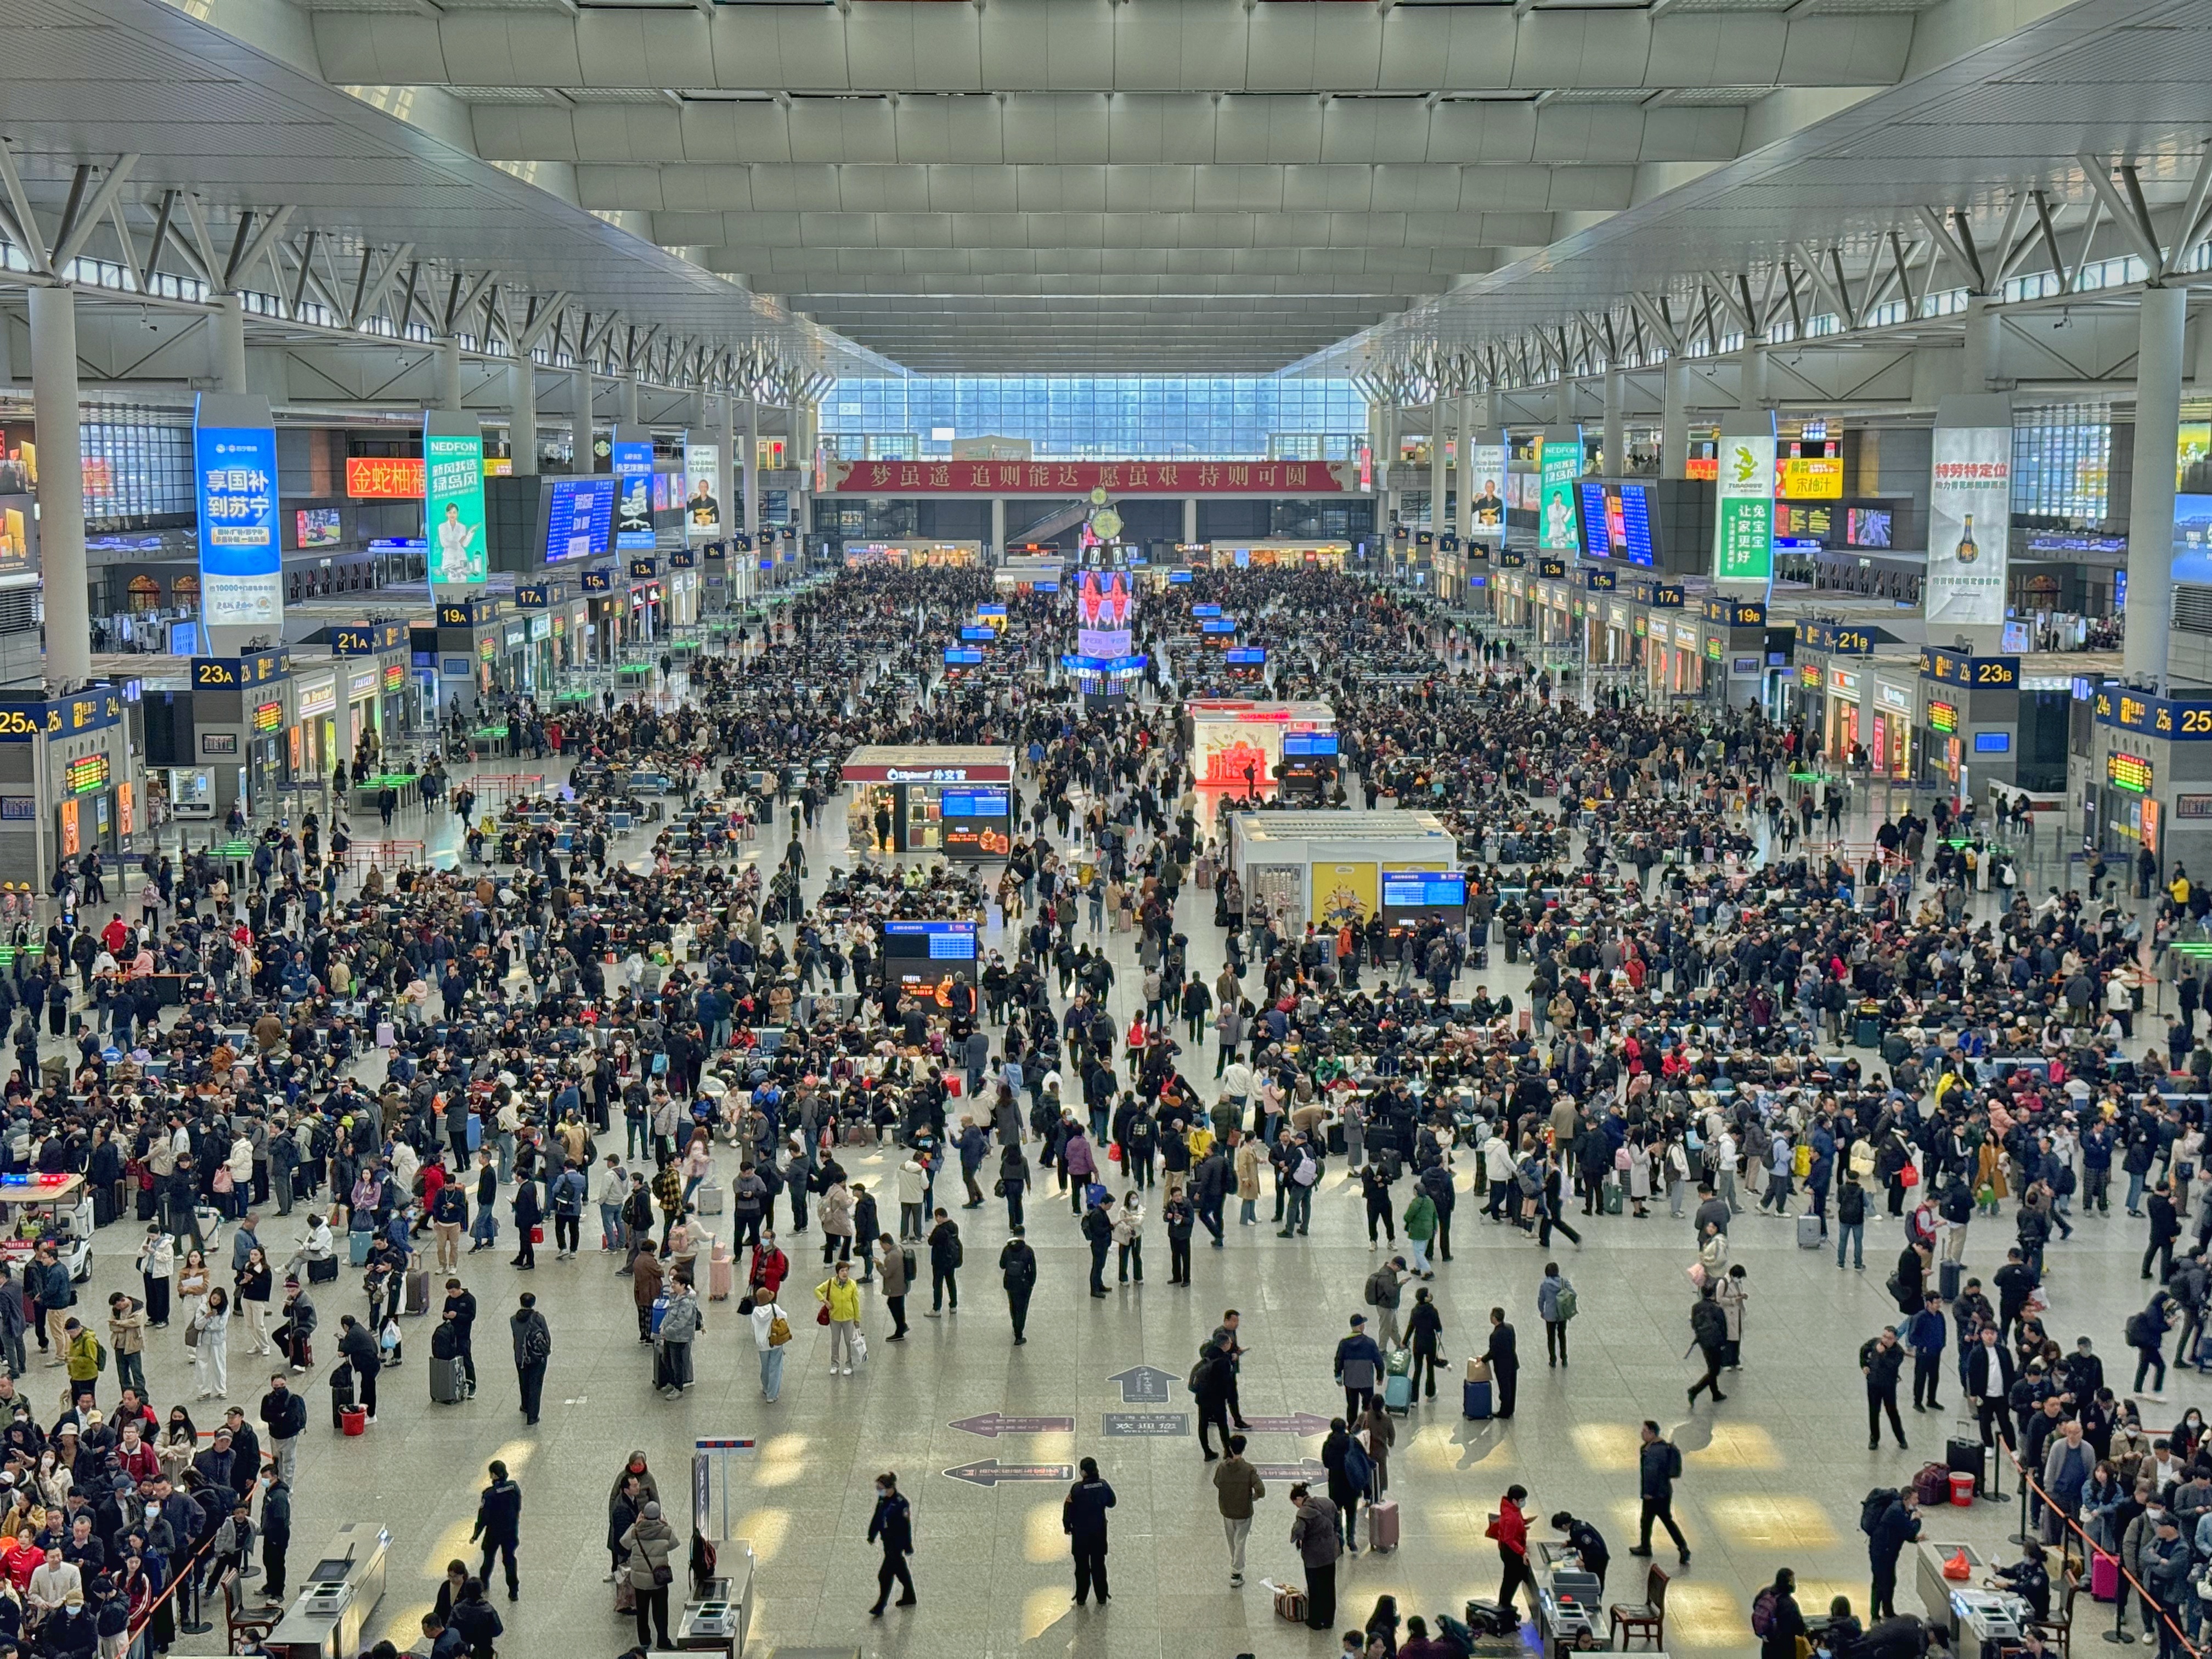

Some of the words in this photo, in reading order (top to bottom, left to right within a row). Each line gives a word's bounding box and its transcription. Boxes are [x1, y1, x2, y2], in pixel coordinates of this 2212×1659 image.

[431, 442, 477, 452] NEDFON
[432, 458, 478, 477] 新风我选
[870, 464, 950, 487] 梦虽遥
[970, 464, 1080, 487] 追则能达
[1099, 464, 1178, 487] 愿虽艰
[1198, 464, 1307, 487] 持则可圆
[1935, 462, 2007, 478] 特劳特定位
[205, 469, 269, 492] 享国补
[433, 471, 478, 493] 绿岛风
[207, 495, 270, 518] 到苏宁
[674, 555, 689, 565] 11A
[709, 548, 719, 556] 9A
[634, 564, 651, 574] 13A
[1544, 564, 1561, 574] 13B
[586, 576, 605, 586] 15A
[521, 591, 541, 603] 17A
[1658, 590, 1679, 602] 17B
[443, 609, 466, 623] 19A
[1737, 608, 1760, 622] 19B
[338, 634, 368, 648] 21A
[1839, 632, 1868, 647] 21B
[280, 655, 289, 672] 22A
[200, 665, 234, 683] 23A
[1979, 664, 2012, 682] 23B
[106, 696, 120, 717] 24A
[2097, 694, 2111, 716] 24B
[0, 712, 38, 733] 25A
[48, 710, 63, 732] 25A
[2156, 708, 2172, 731] 25B
[2181, 710, 2212, 732] 25
